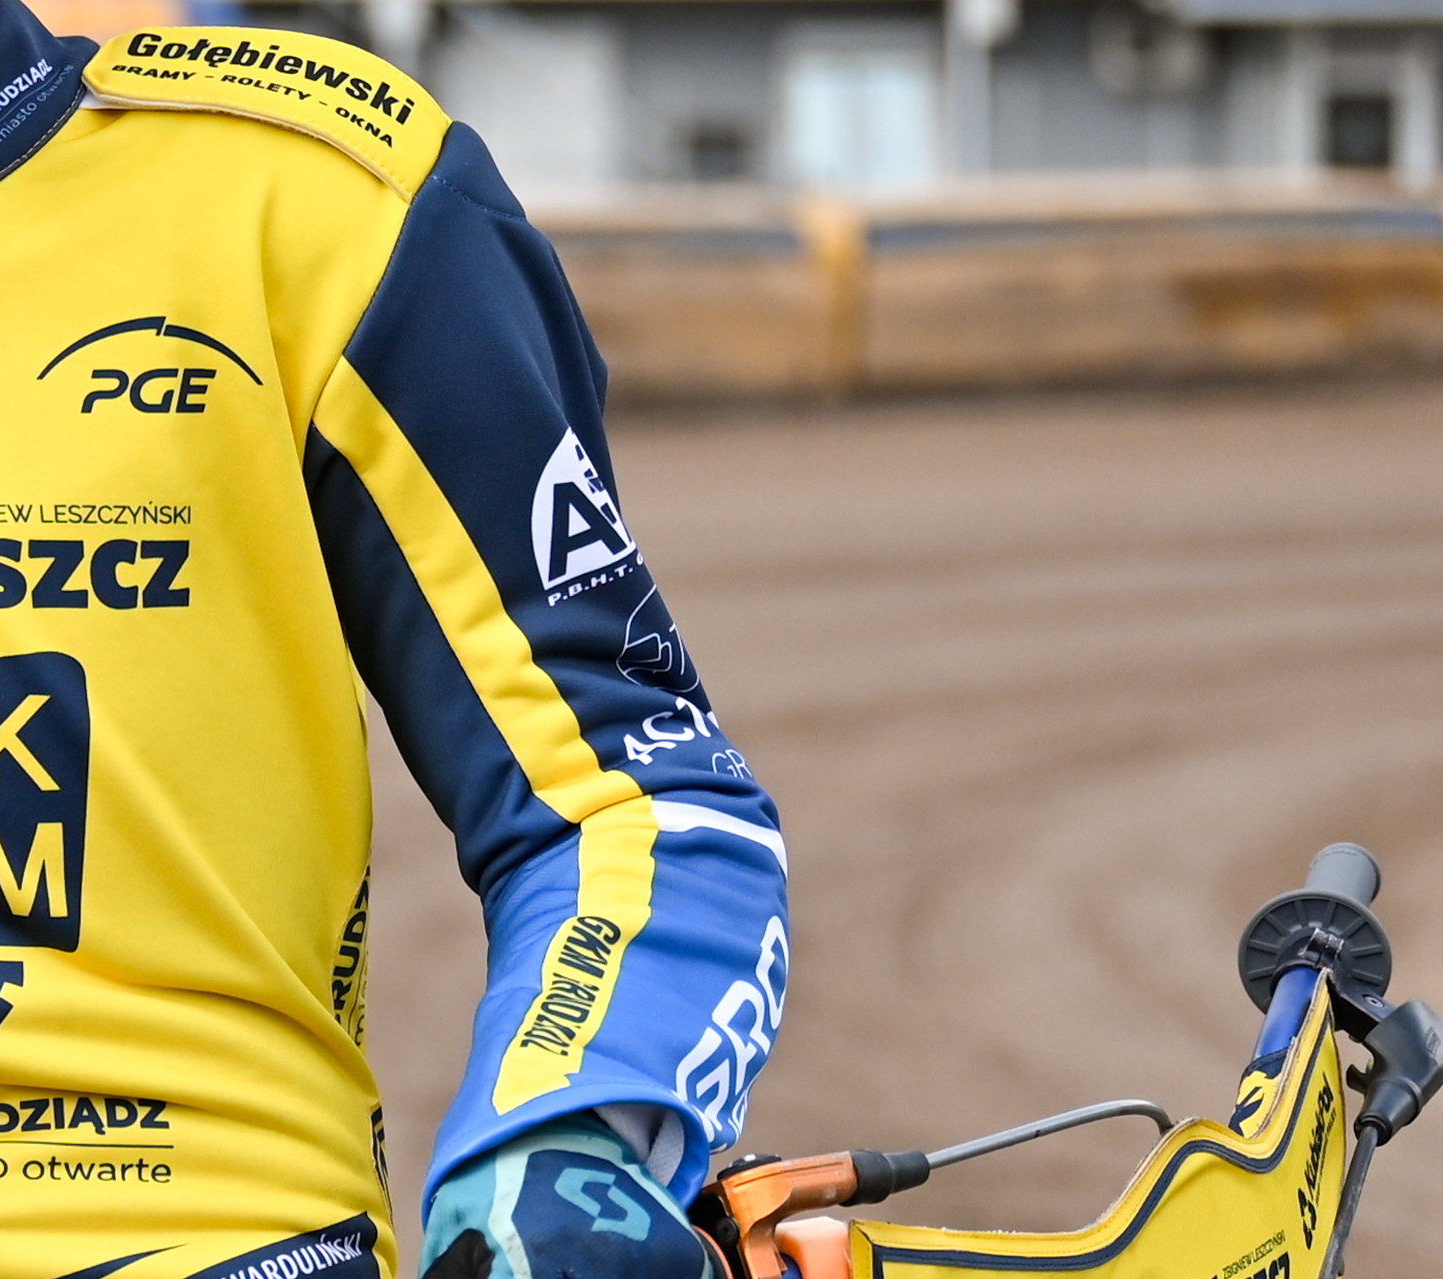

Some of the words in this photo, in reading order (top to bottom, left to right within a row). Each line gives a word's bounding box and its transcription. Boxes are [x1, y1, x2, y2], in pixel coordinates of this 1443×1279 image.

[126, 32, 415, 125] Gołębiewski
[112, 64, 195, 82] BRAMY
[221, 74, 312, 101] ROLETY
[334, 106, 394, 148] OKNA
[80, 368, 217, 414] PGE
[40, 500, 192, 525] LESZCZYŃSKI
[22, 1155, 172, 1184] otwarte
